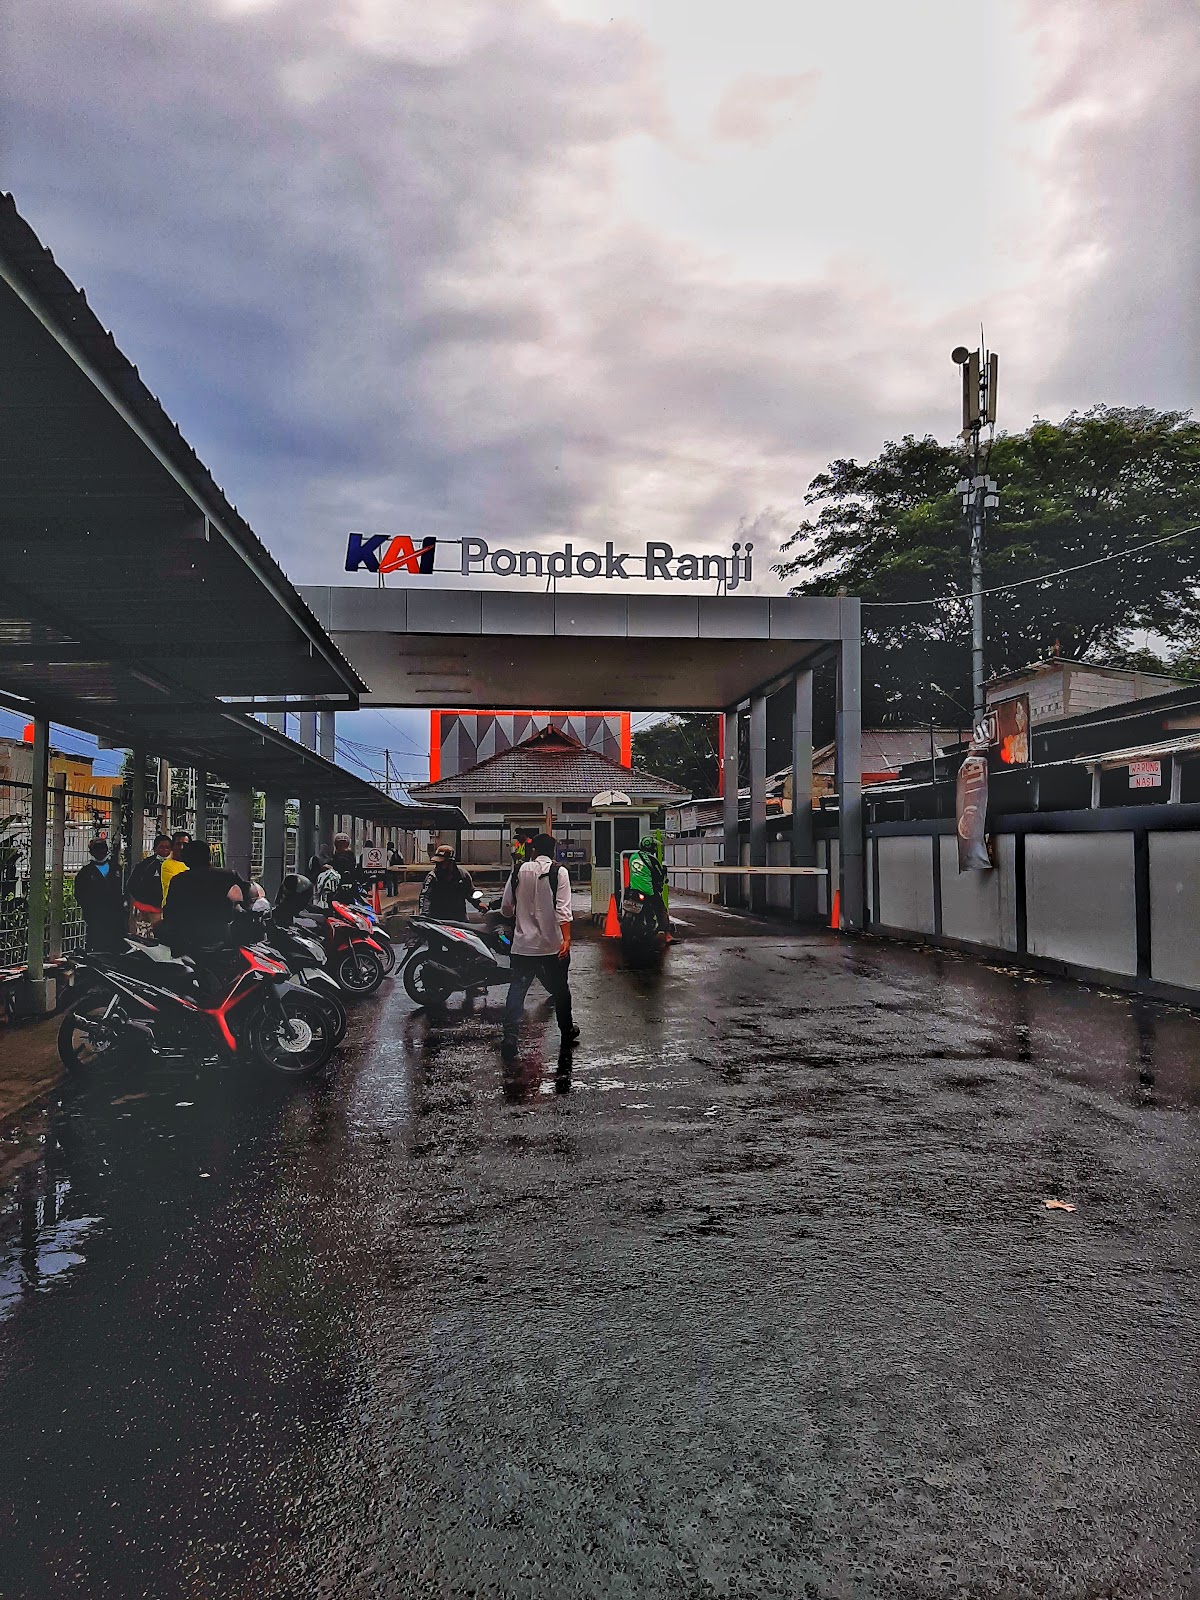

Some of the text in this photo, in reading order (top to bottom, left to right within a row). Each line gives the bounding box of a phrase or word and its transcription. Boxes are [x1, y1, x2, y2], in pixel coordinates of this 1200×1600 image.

[345, 533, 753, 590] KAI Pondok Ranji
[1131, 761, 1159, 773] WARUNG
[1136, 777, 1154, 787] NASI
